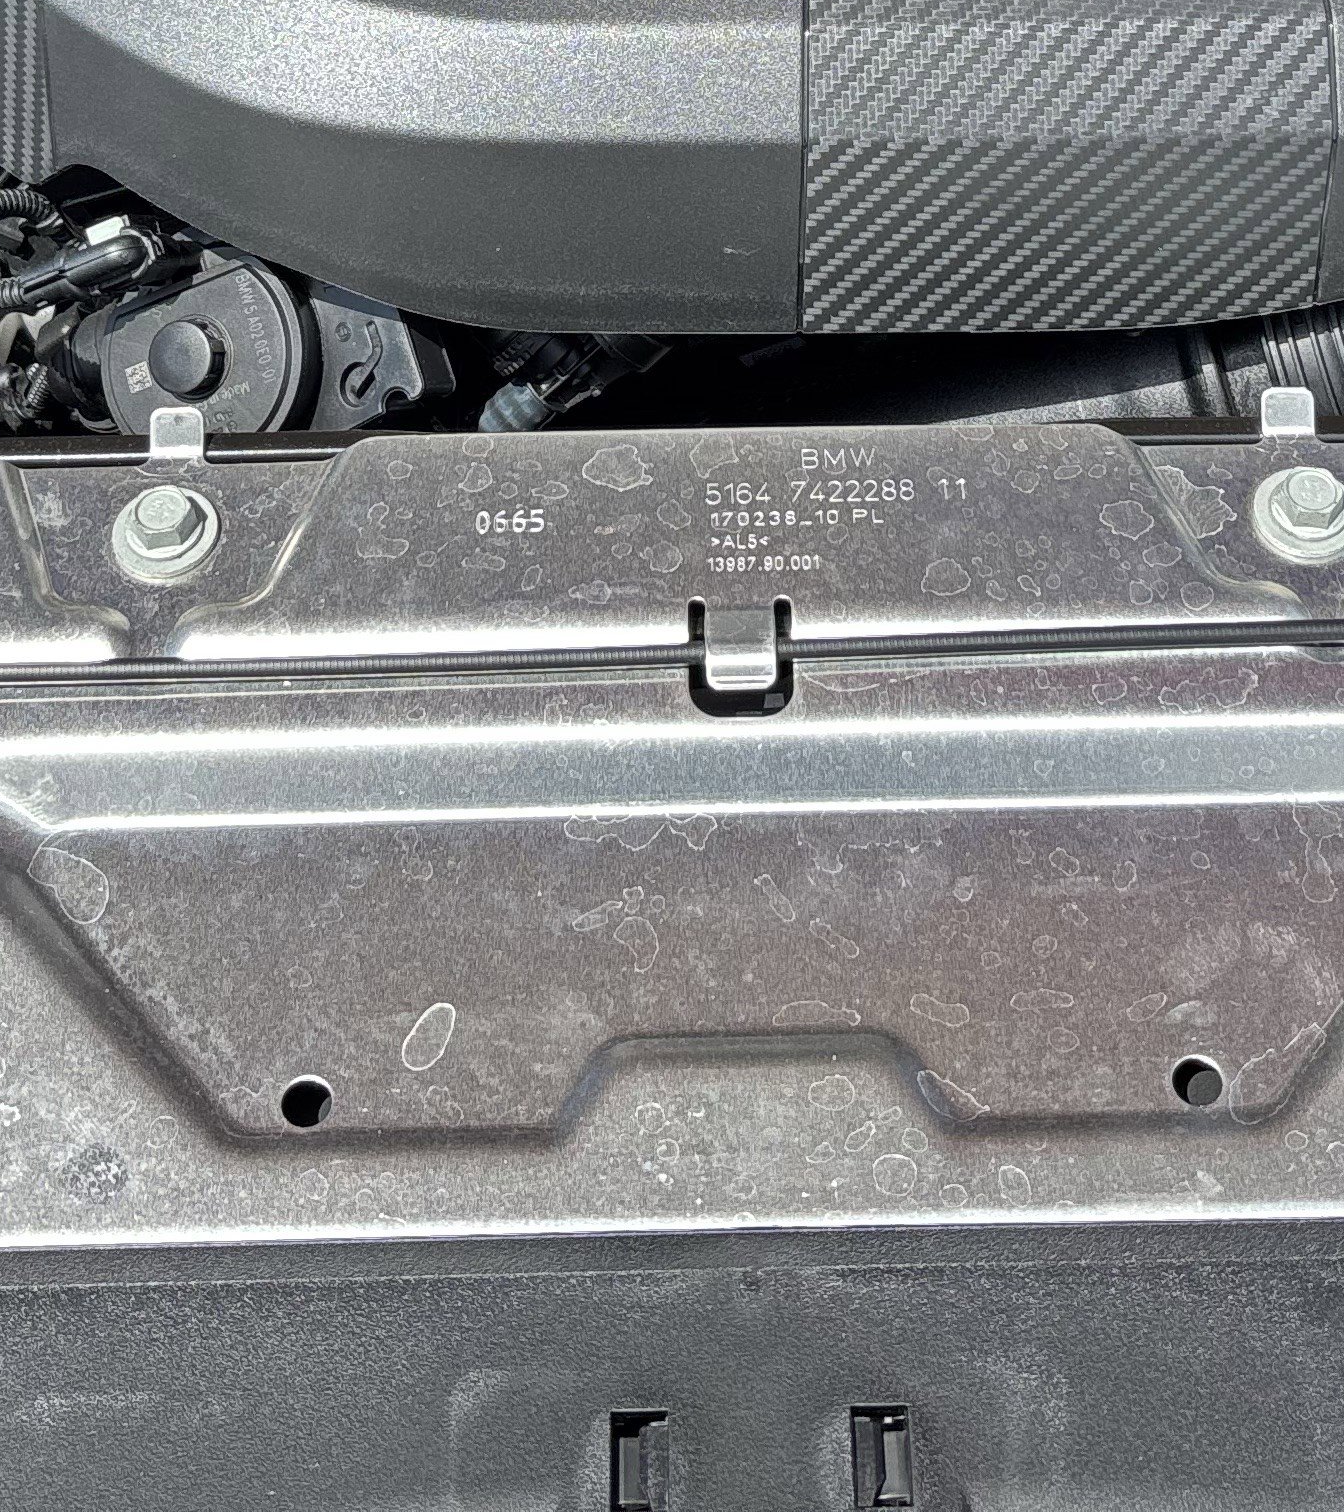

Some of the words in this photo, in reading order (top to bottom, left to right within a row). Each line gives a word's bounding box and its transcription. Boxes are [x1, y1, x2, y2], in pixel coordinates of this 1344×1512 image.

[235, 273, 256, 305] BMW
[800, 446, 876, 470] BMW
[705, 481, 772, 506] 5164
[789, 478, 915, 503] 7422288
[937, 477, 967, 500] 11
[475, 508, 545, 535] 0665
[710, 509, 839, 527] 170238_10
[851, 508, 885, 524] PL
